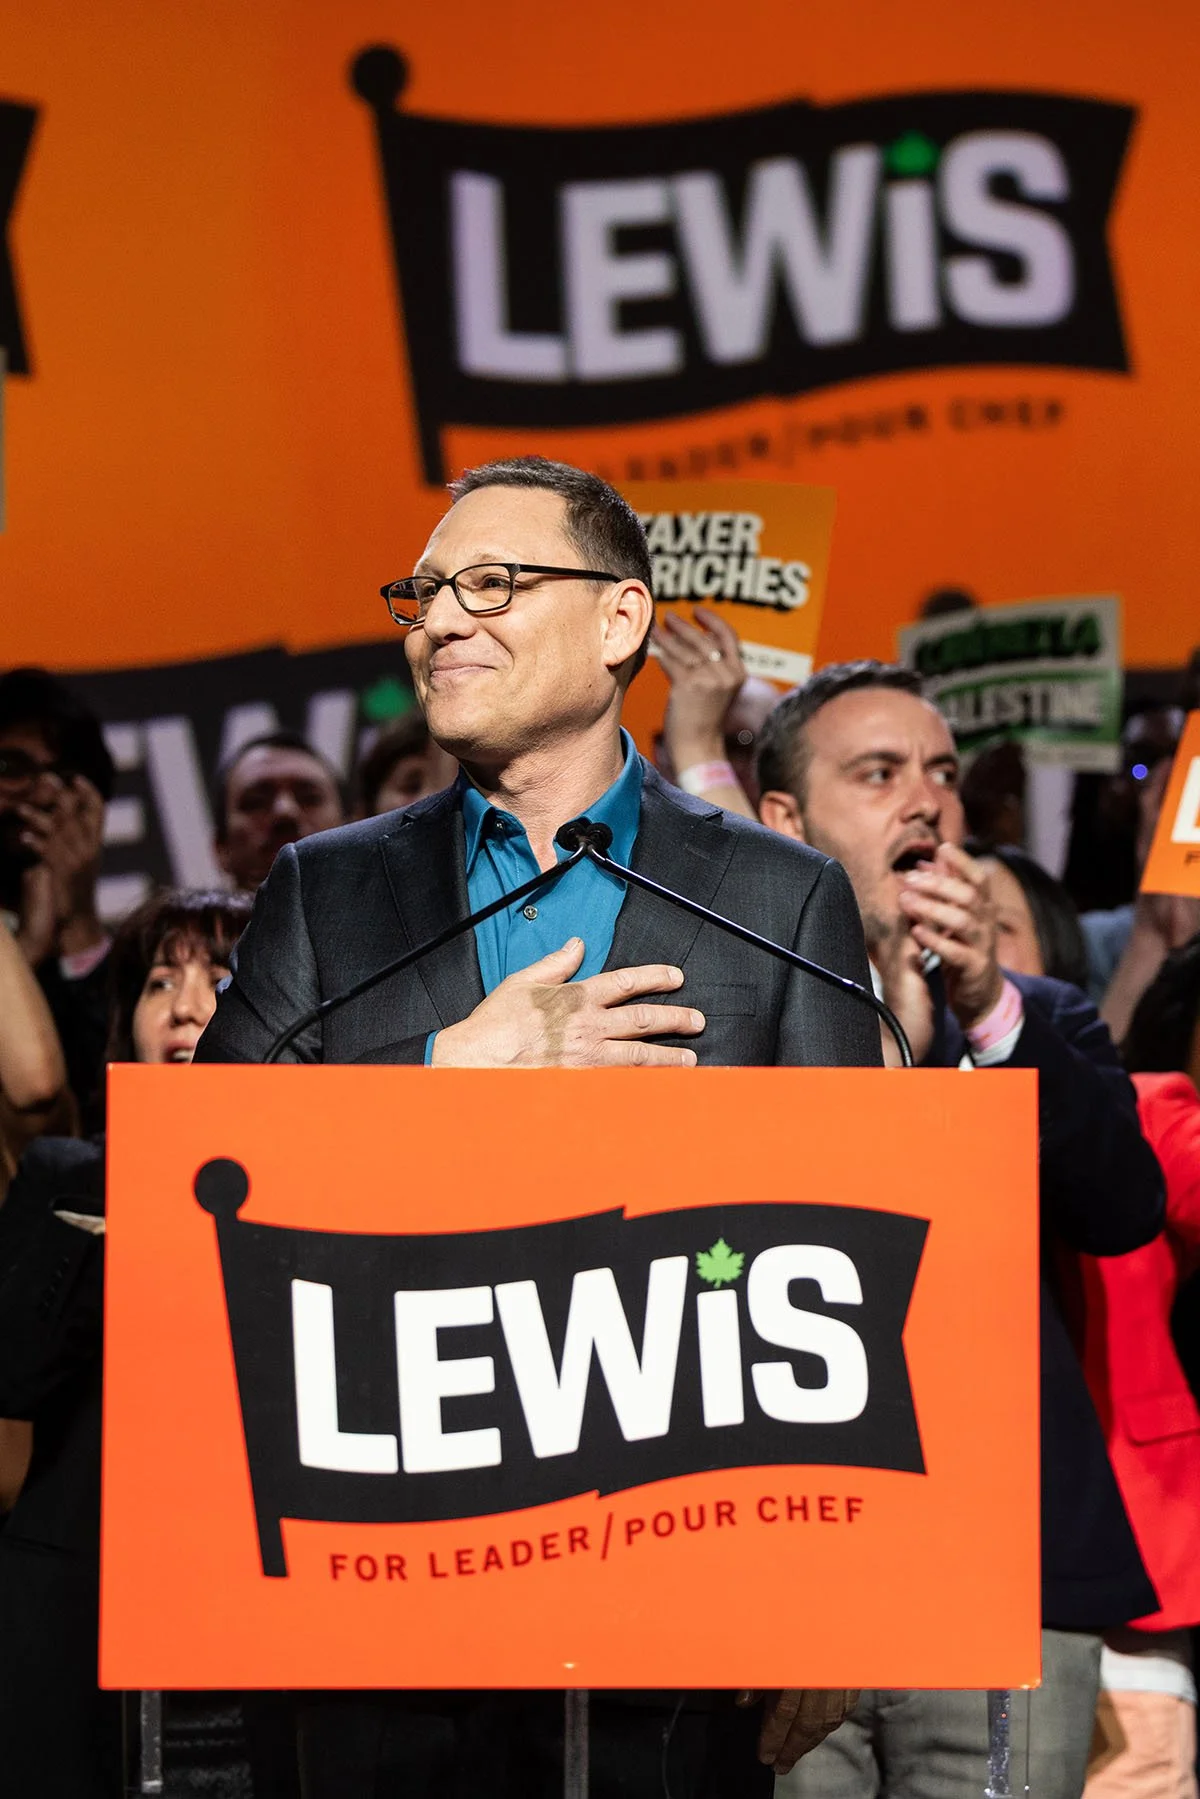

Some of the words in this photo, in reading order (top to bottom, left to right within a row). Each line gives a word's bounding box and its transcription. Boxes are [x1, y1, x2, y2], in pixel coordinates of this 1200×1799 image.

[652, 555, 811, 608] RICHES
[330, 1552, 408, 1582] FOR
[757, 1496, 864, 1524] CHEF
